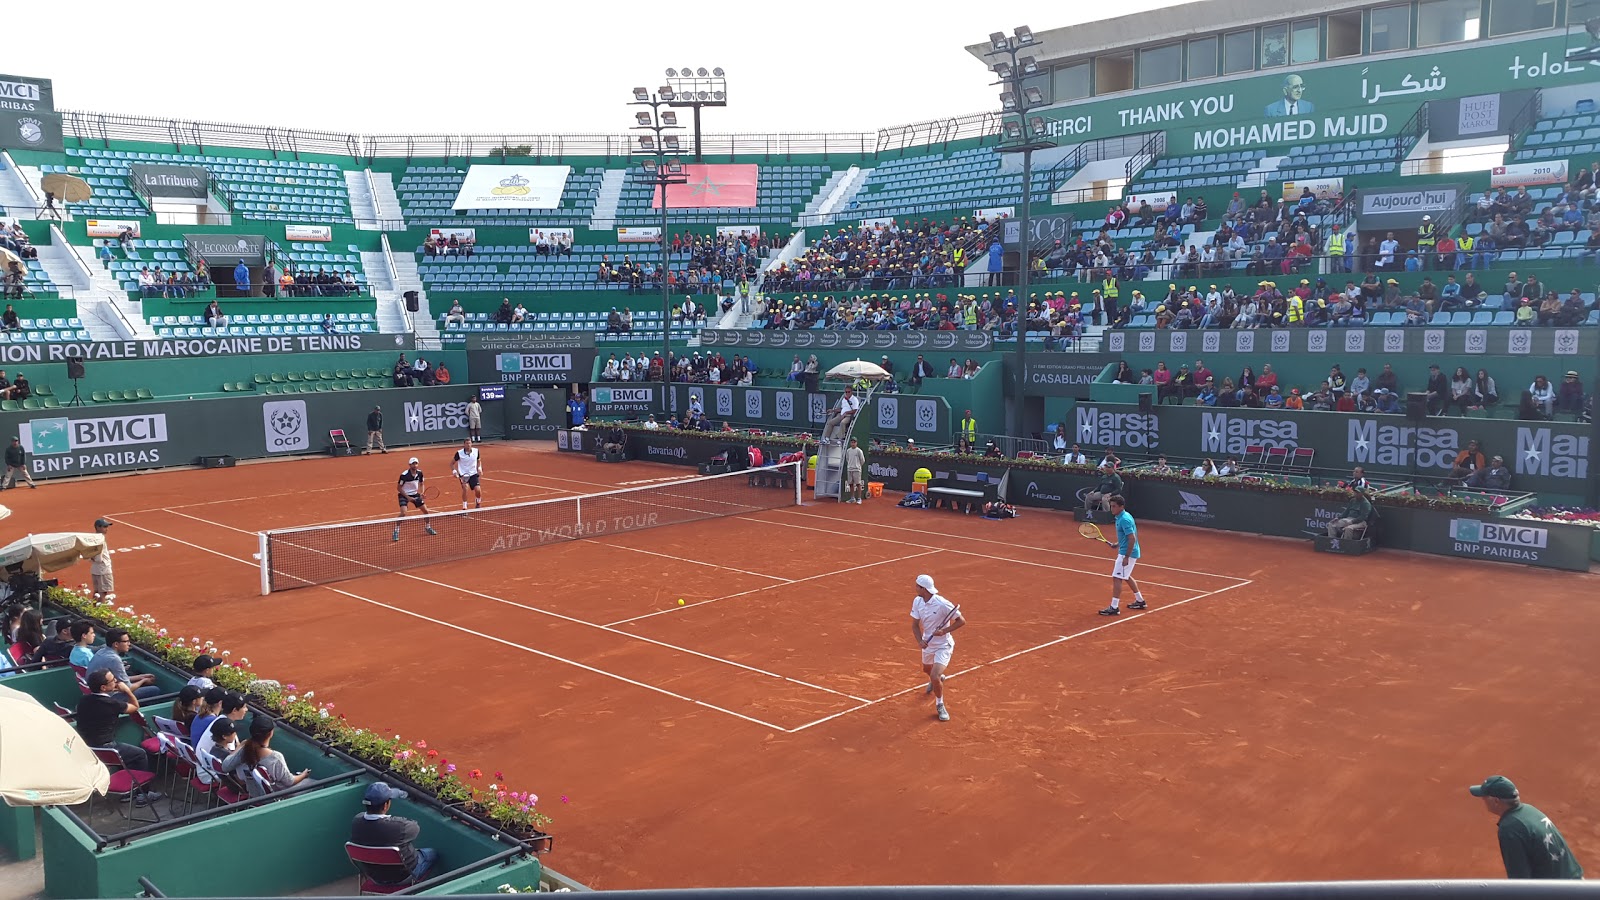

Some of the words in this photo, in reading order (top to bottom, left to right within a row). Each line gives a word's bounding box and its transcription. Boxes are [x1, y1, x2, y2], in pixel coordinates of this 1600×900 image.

[1118, 101, 1184, 128] THANK
[1190, 94, 1234, 117] YOU
[1465, 100, 1496, 112] HUFF
[1460, 119, 1496, 130] MAROC
[1464, 110, 1496, 121] POST
[1193, 120, 1316, 150] MOHAMED
[1323, 113, 1388, 138] MJID
[145, 173, 157, 186] La
[160, 174, 199, 187] Tribune
[1371, 192, 1446, 210] Aujourd'hui
[49, 342, 137, 361] ROYALE
[143, 337, 262, 357] MAROCAINE
[267, 337, 292, 352] DE
[297, 335, 361, 351] TENNIS
[522, 355, 566, 369] BMCI
[501, 374, 522, 382] BNP
[524, 373, 567, 381] PARIBAS
[1032, 373, 1098, 385] CASABLANC
[613, 389, 648, 401] BMCI
[404, 401, 468, 418] Marsa
[405, 415, 470, 433] Maroc
[1076, 407, 1159, 432] Marsa
[1202, 412, 1298, 439] Marsa
[74, 416, 157, 445] BMCI
[1076, 427, 1159, 449] Maroc
[1348, 418, 1459, 448] Marsa
[273, 436, 301, 448] OCP
[647, 445, 673, 456] Bavaria
[1516, 427, 1589, 456] Mar
[33, 455, 75, 473] BNP
[79, 449, 160, 469] PARIBAS
[1348, 445, 1458, 470] Maroc
[1516, 453, 1588, 479] Mar
[1031, 492, 1061, 501] HEAD
[1314, 507, 1342, 519] Maro
[490, 531, 531, 551] ATP
[539, 519, 607, 543] WORLD
[613, 512, 658, 530] TOUR
[1305, 517, 1329, 529] Telec
[1482, 524, 1539, 545] BMCI
[1454, 542, 1480, 553] BNP
[1483, 546, 1538, 561] PARIBAS
